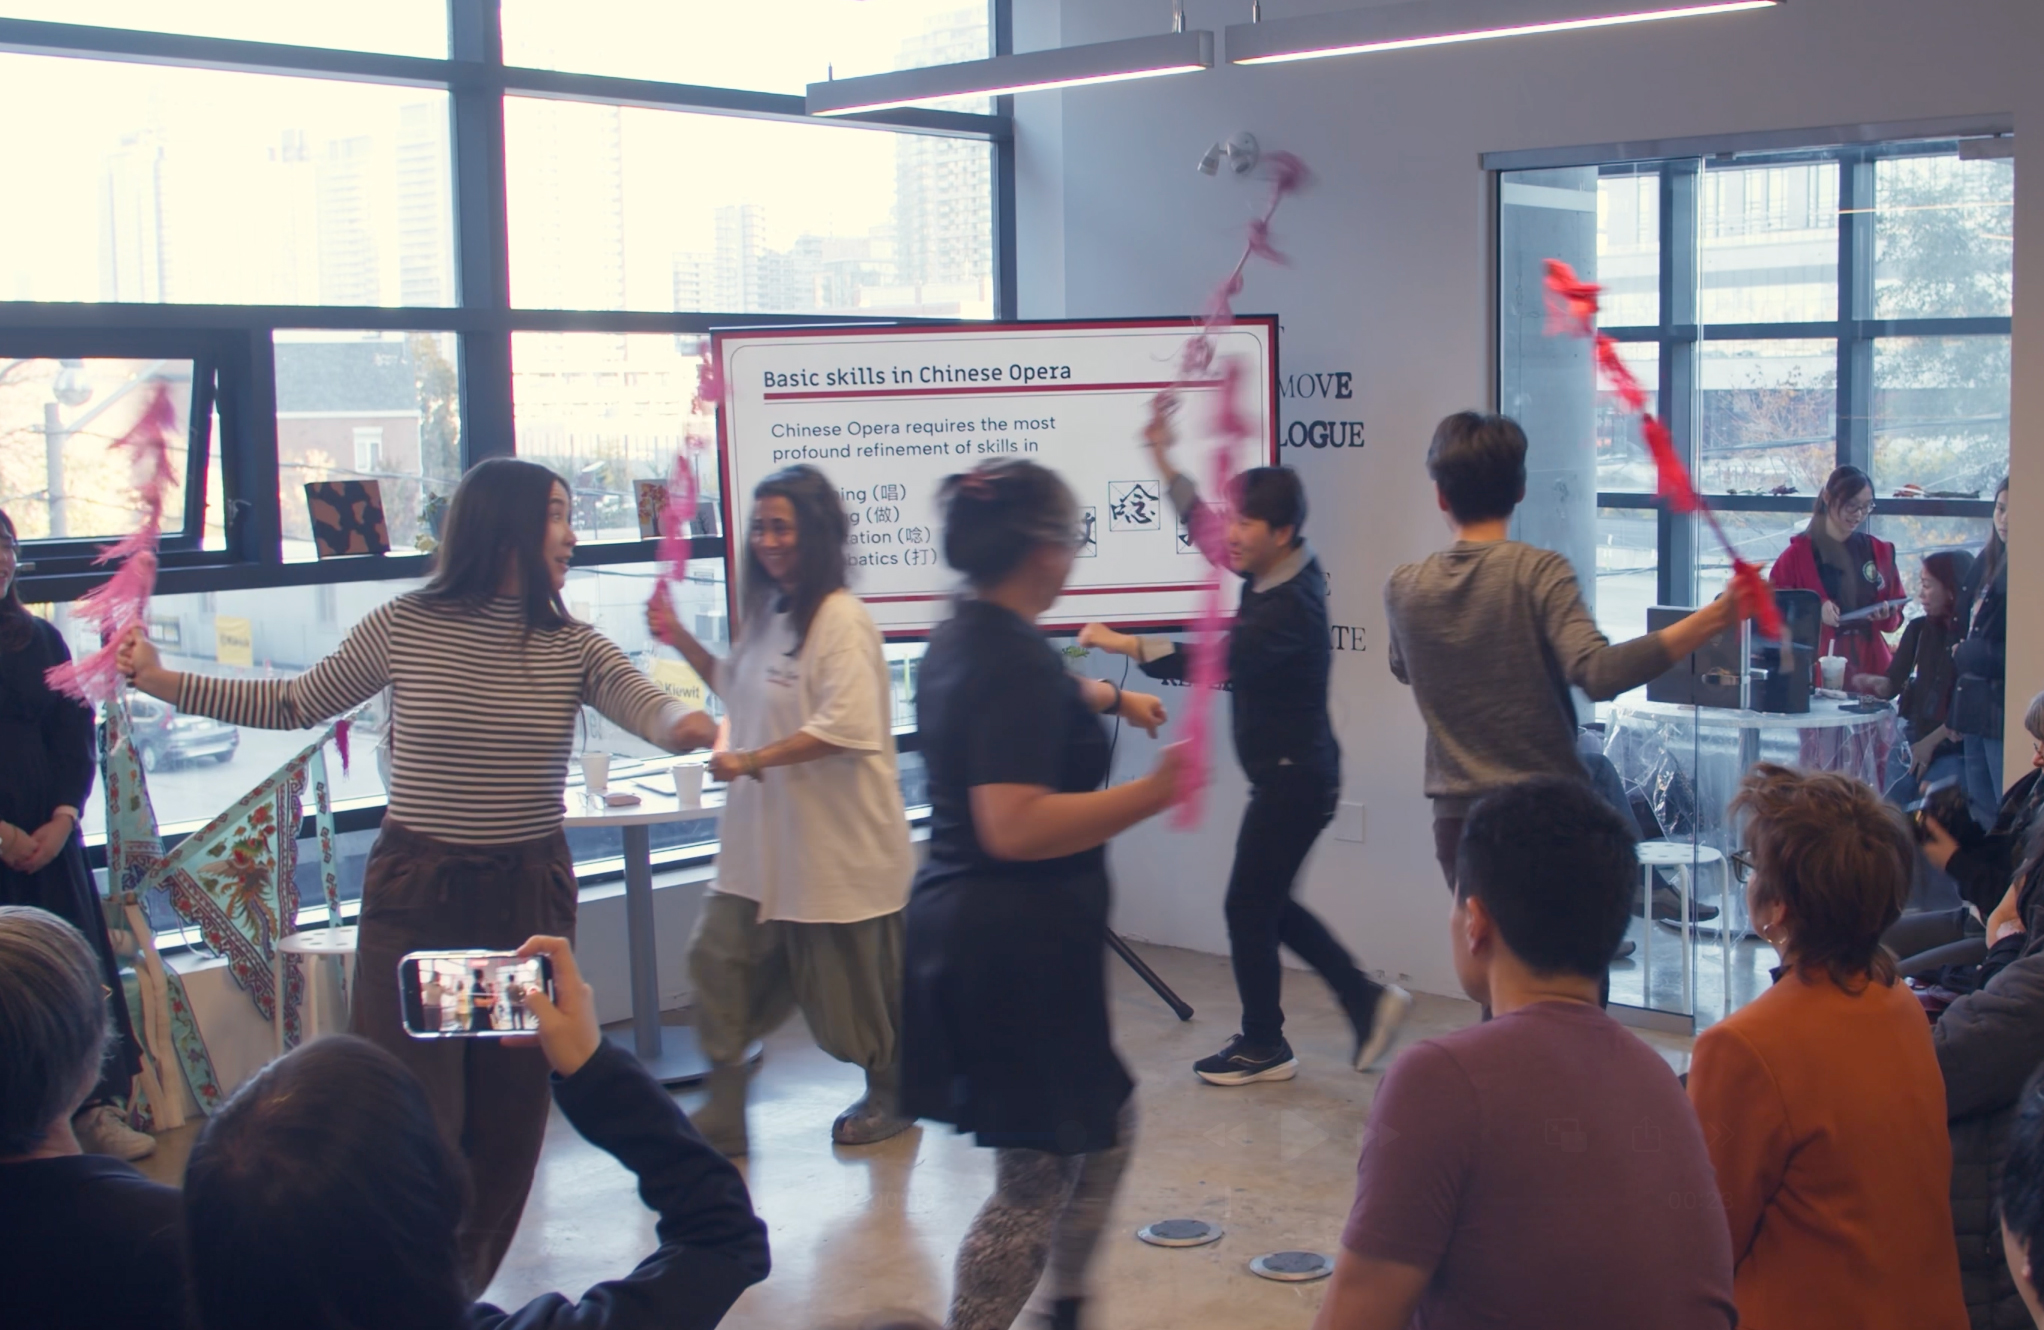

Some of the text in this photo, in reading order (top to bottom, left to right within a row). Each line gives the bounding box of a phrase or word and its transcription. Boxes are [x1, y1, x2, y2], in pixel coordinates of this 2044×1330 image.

[763, 364, 1072, 388] Basic skills in Chinese Opera
[772, 417, 1055, 438] Chinese Opera requires the most
[773, 438, 1038, 463] profound refinement of skills in
[873, 484, 906, 501] (唱)
[866, 506, 899, 524] (做)
[898, 527, 930, 544] (唸)
[904, 547, 938, 566] (打)
